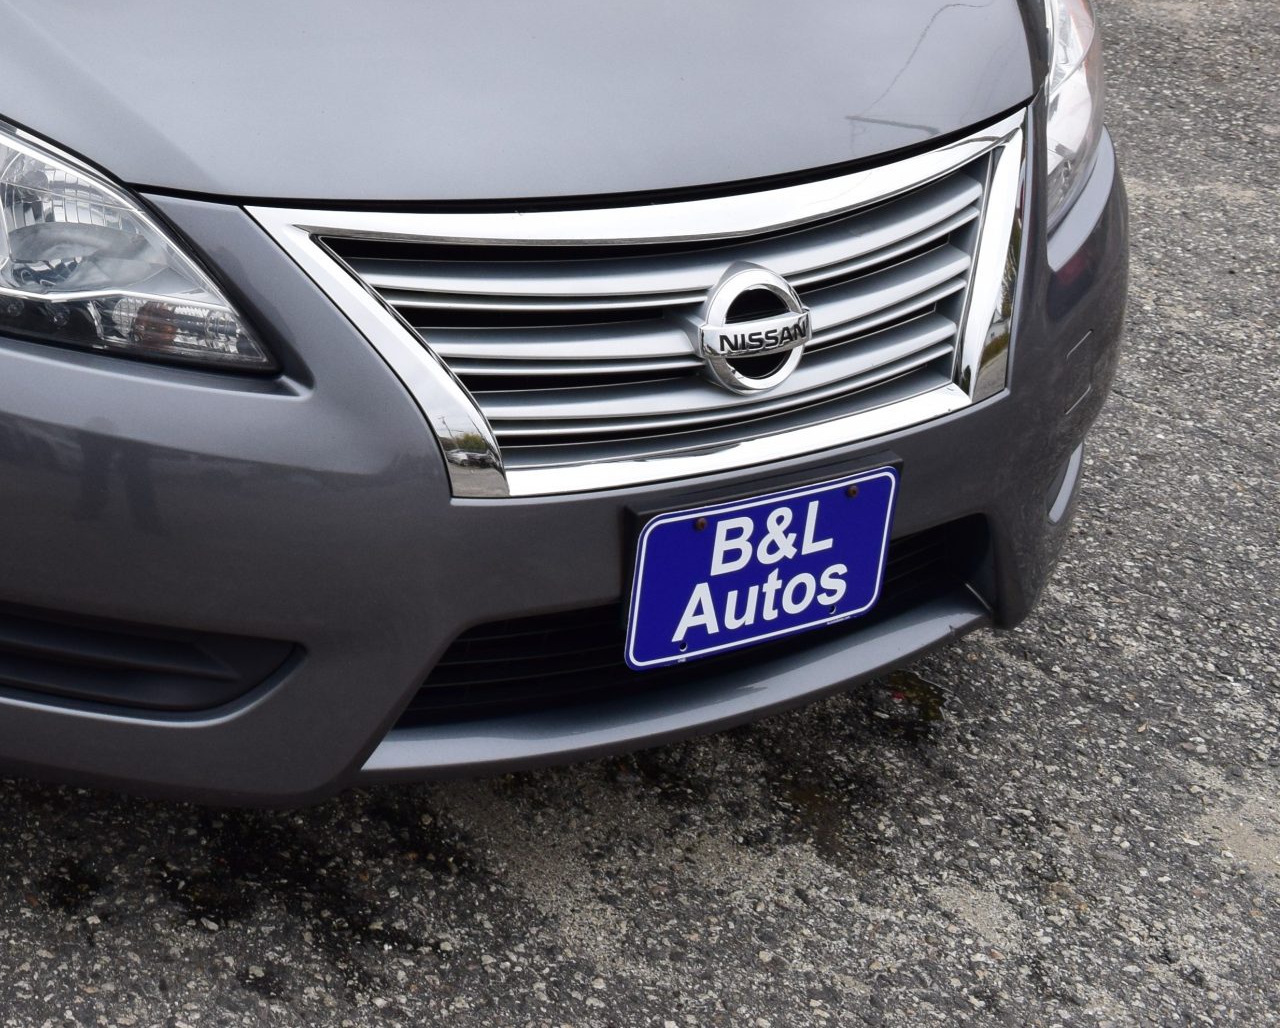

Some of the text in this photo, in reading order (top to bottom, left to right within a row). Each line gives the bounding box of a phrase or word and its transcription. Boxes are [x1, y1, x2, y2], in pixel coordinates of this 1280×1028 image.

[720, 323, 806, 351] NISSAN
[710, 500, 833, 576] B&L
[671, 563, 848, 642] Autos
